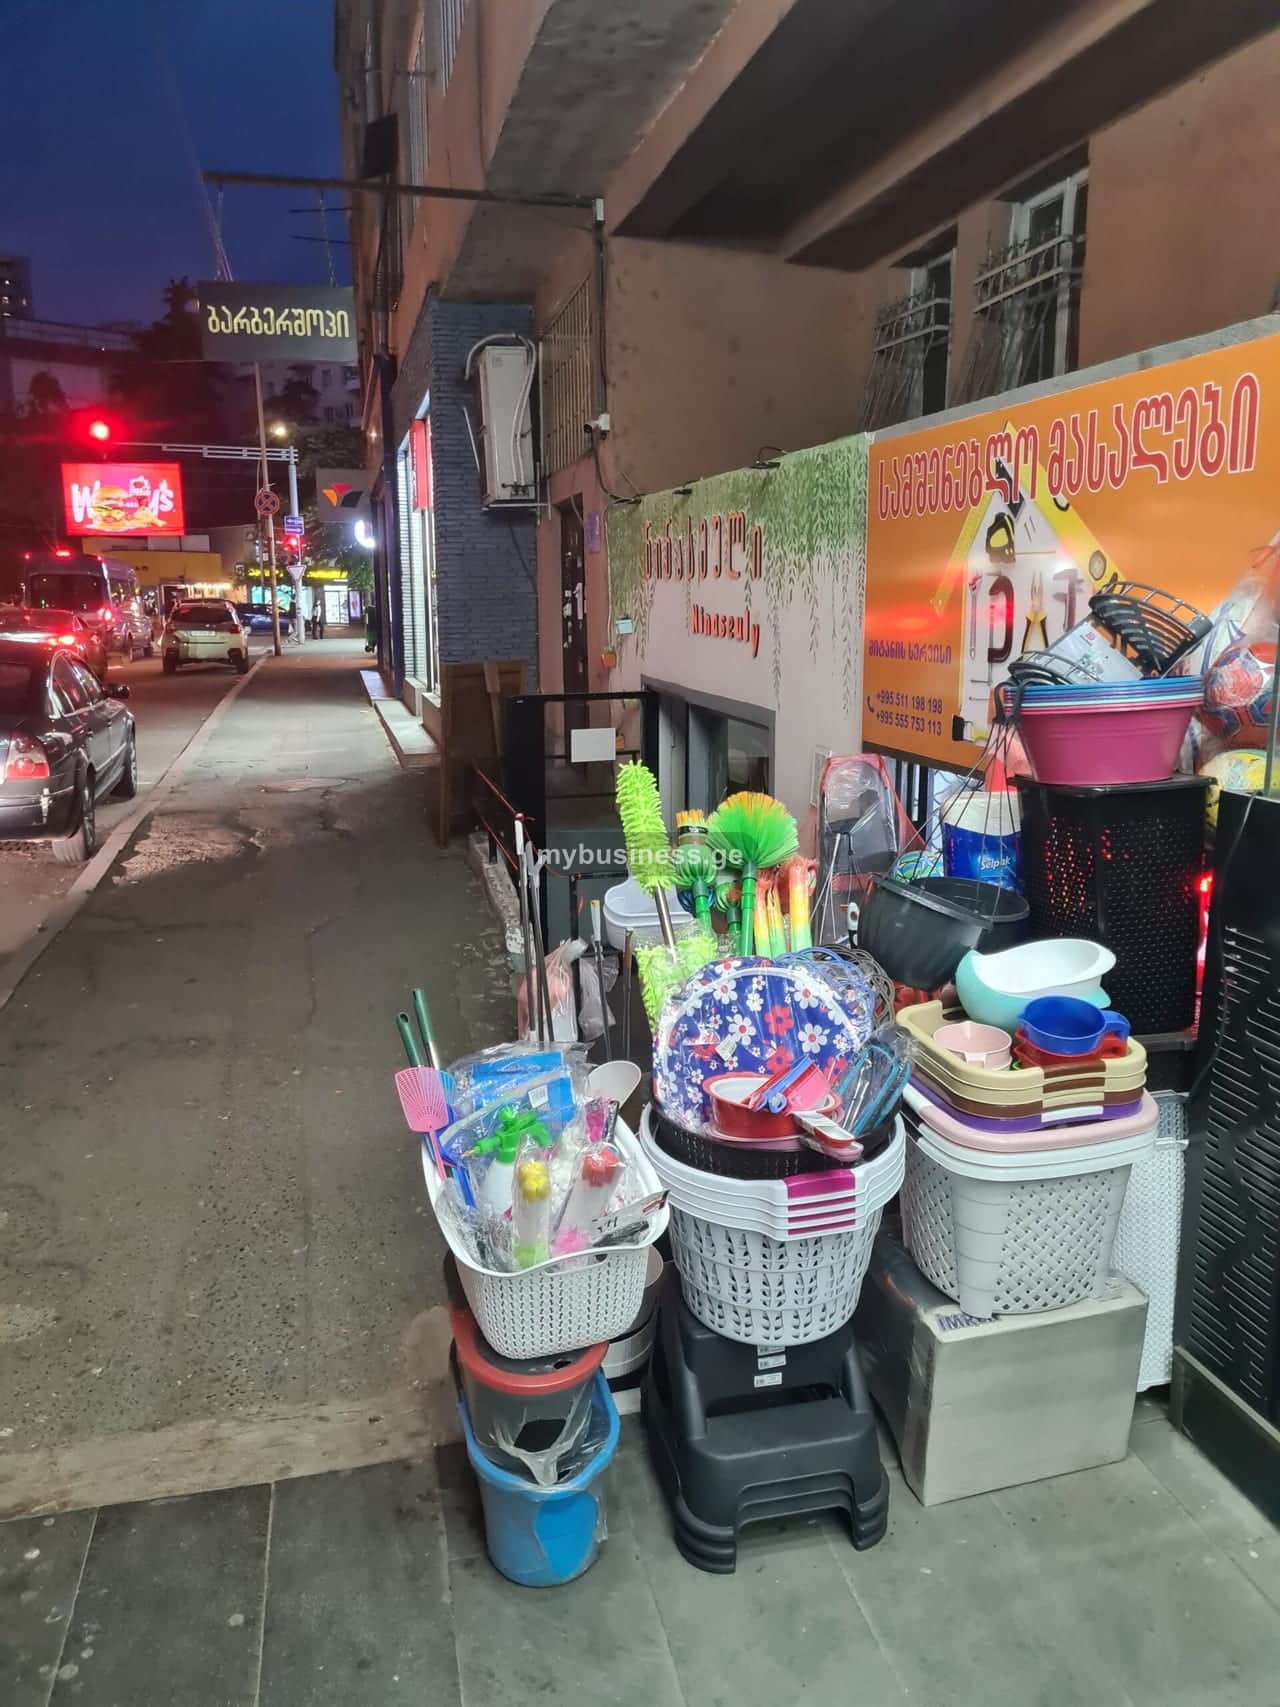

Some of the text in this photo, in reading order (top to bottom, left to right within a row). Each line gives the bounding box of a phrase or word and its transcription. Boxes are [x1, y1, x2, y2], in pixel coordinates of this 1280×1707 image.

[206, 304, 350, 338] ბარბერშოპი
[878, 372, 1260, 521] სამშენებლო მასალები
[876, 689, 943, 714] +995 511 198 198
[876, 710, 942, 736] +995 555 753 113
